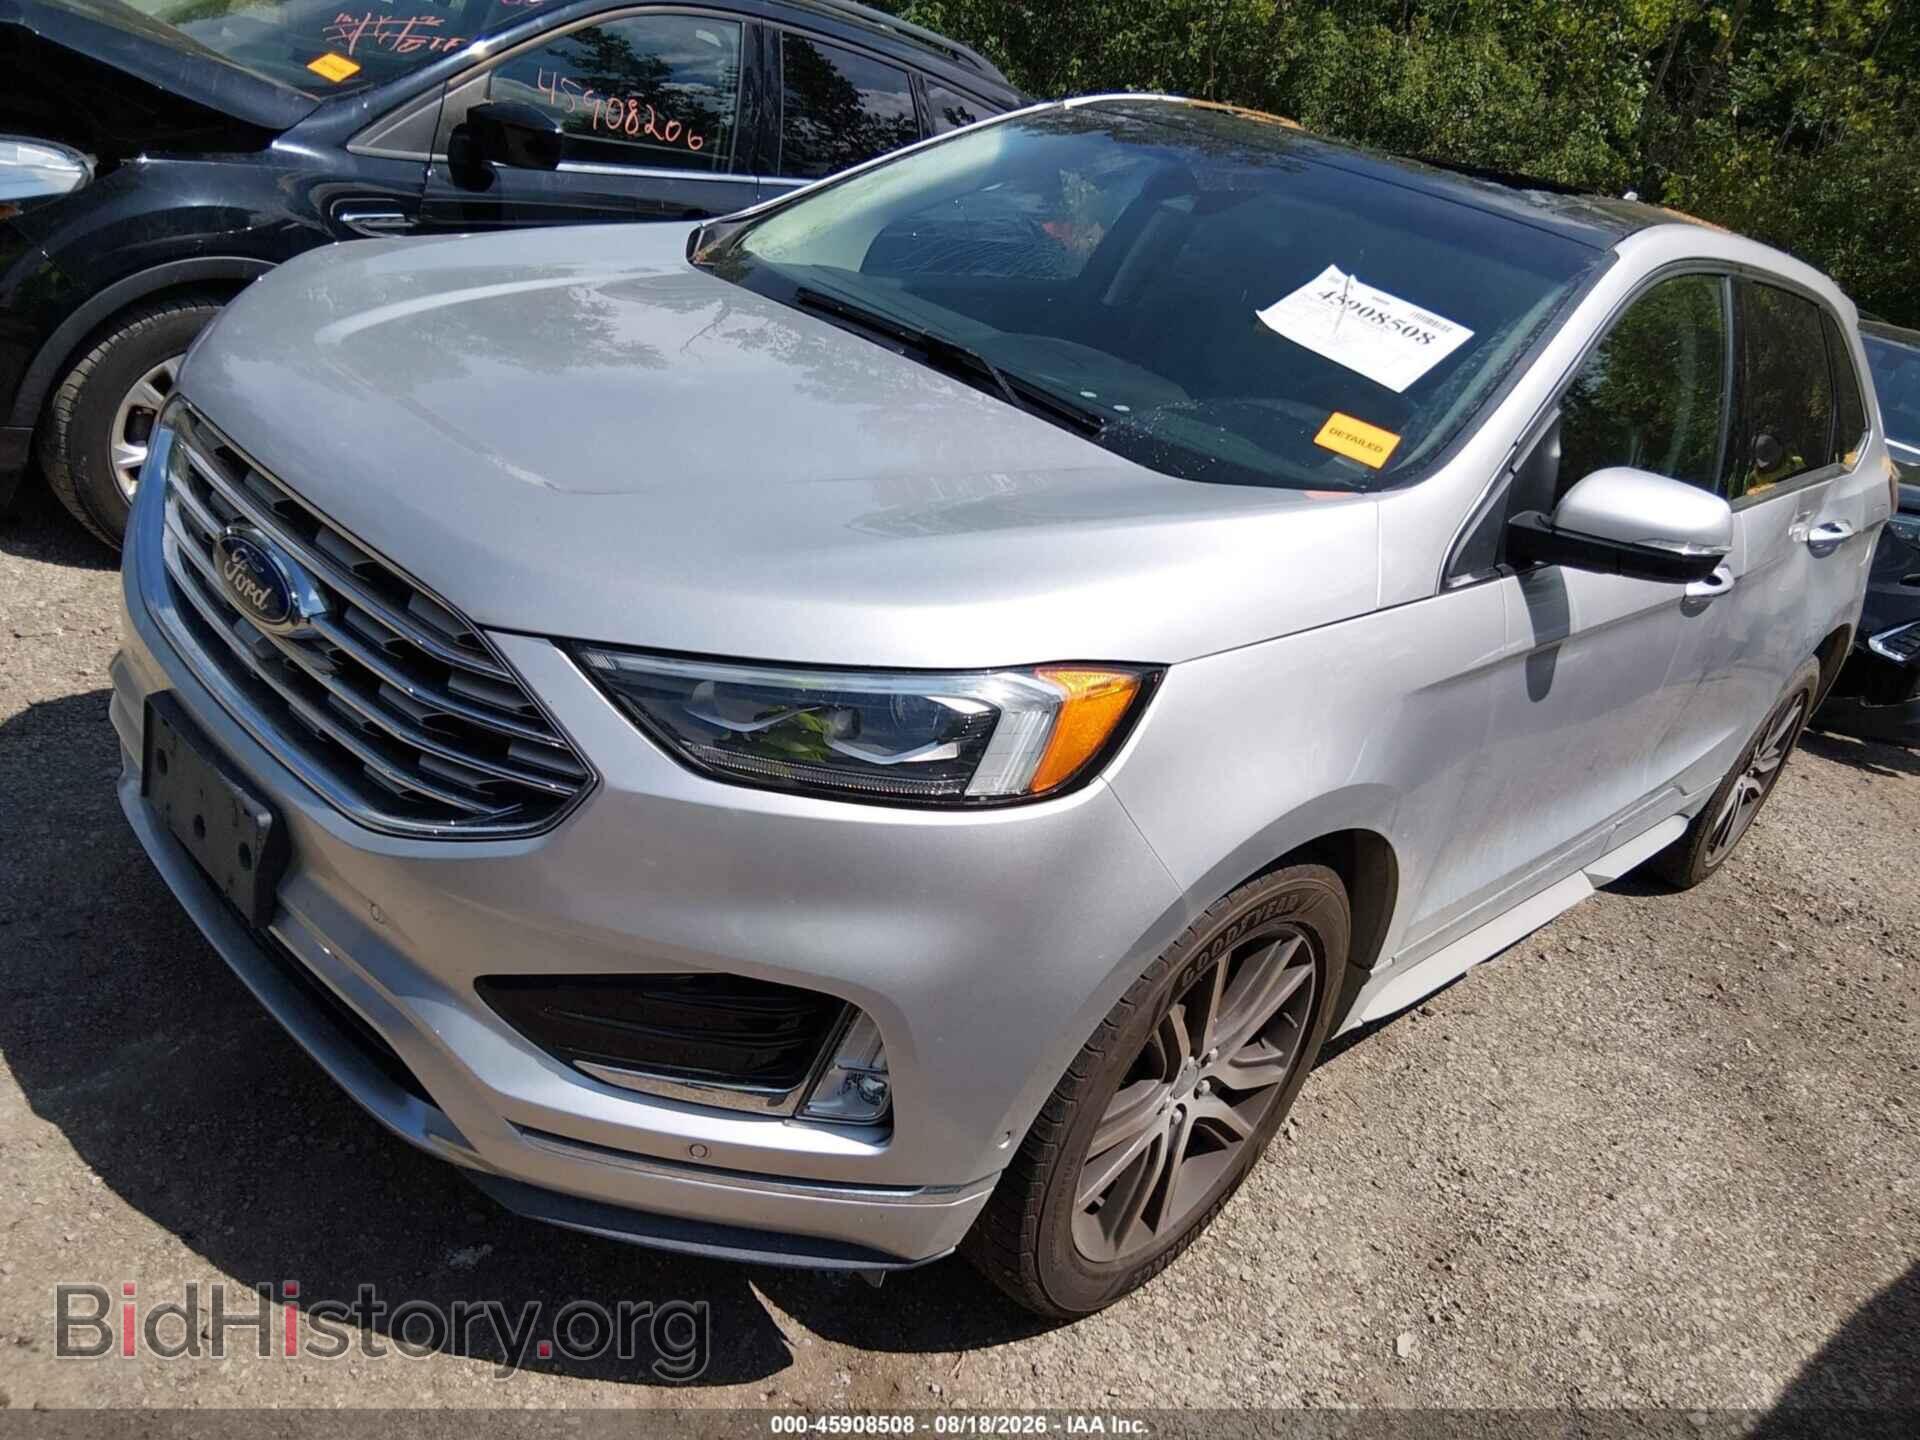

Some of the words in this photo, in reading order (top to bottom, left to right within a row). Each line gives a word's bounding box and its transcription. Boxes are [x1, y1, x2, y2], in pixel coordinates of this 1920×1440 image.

[537, 66, 704, 151] 45908206
[1317, 289, 1437, 346] 45908508
[1327, 426, 1385, 455] DETAILED
[222, 546, 273, 611] Ford
[1181, 893, 1301, 988] GOODYEAR
